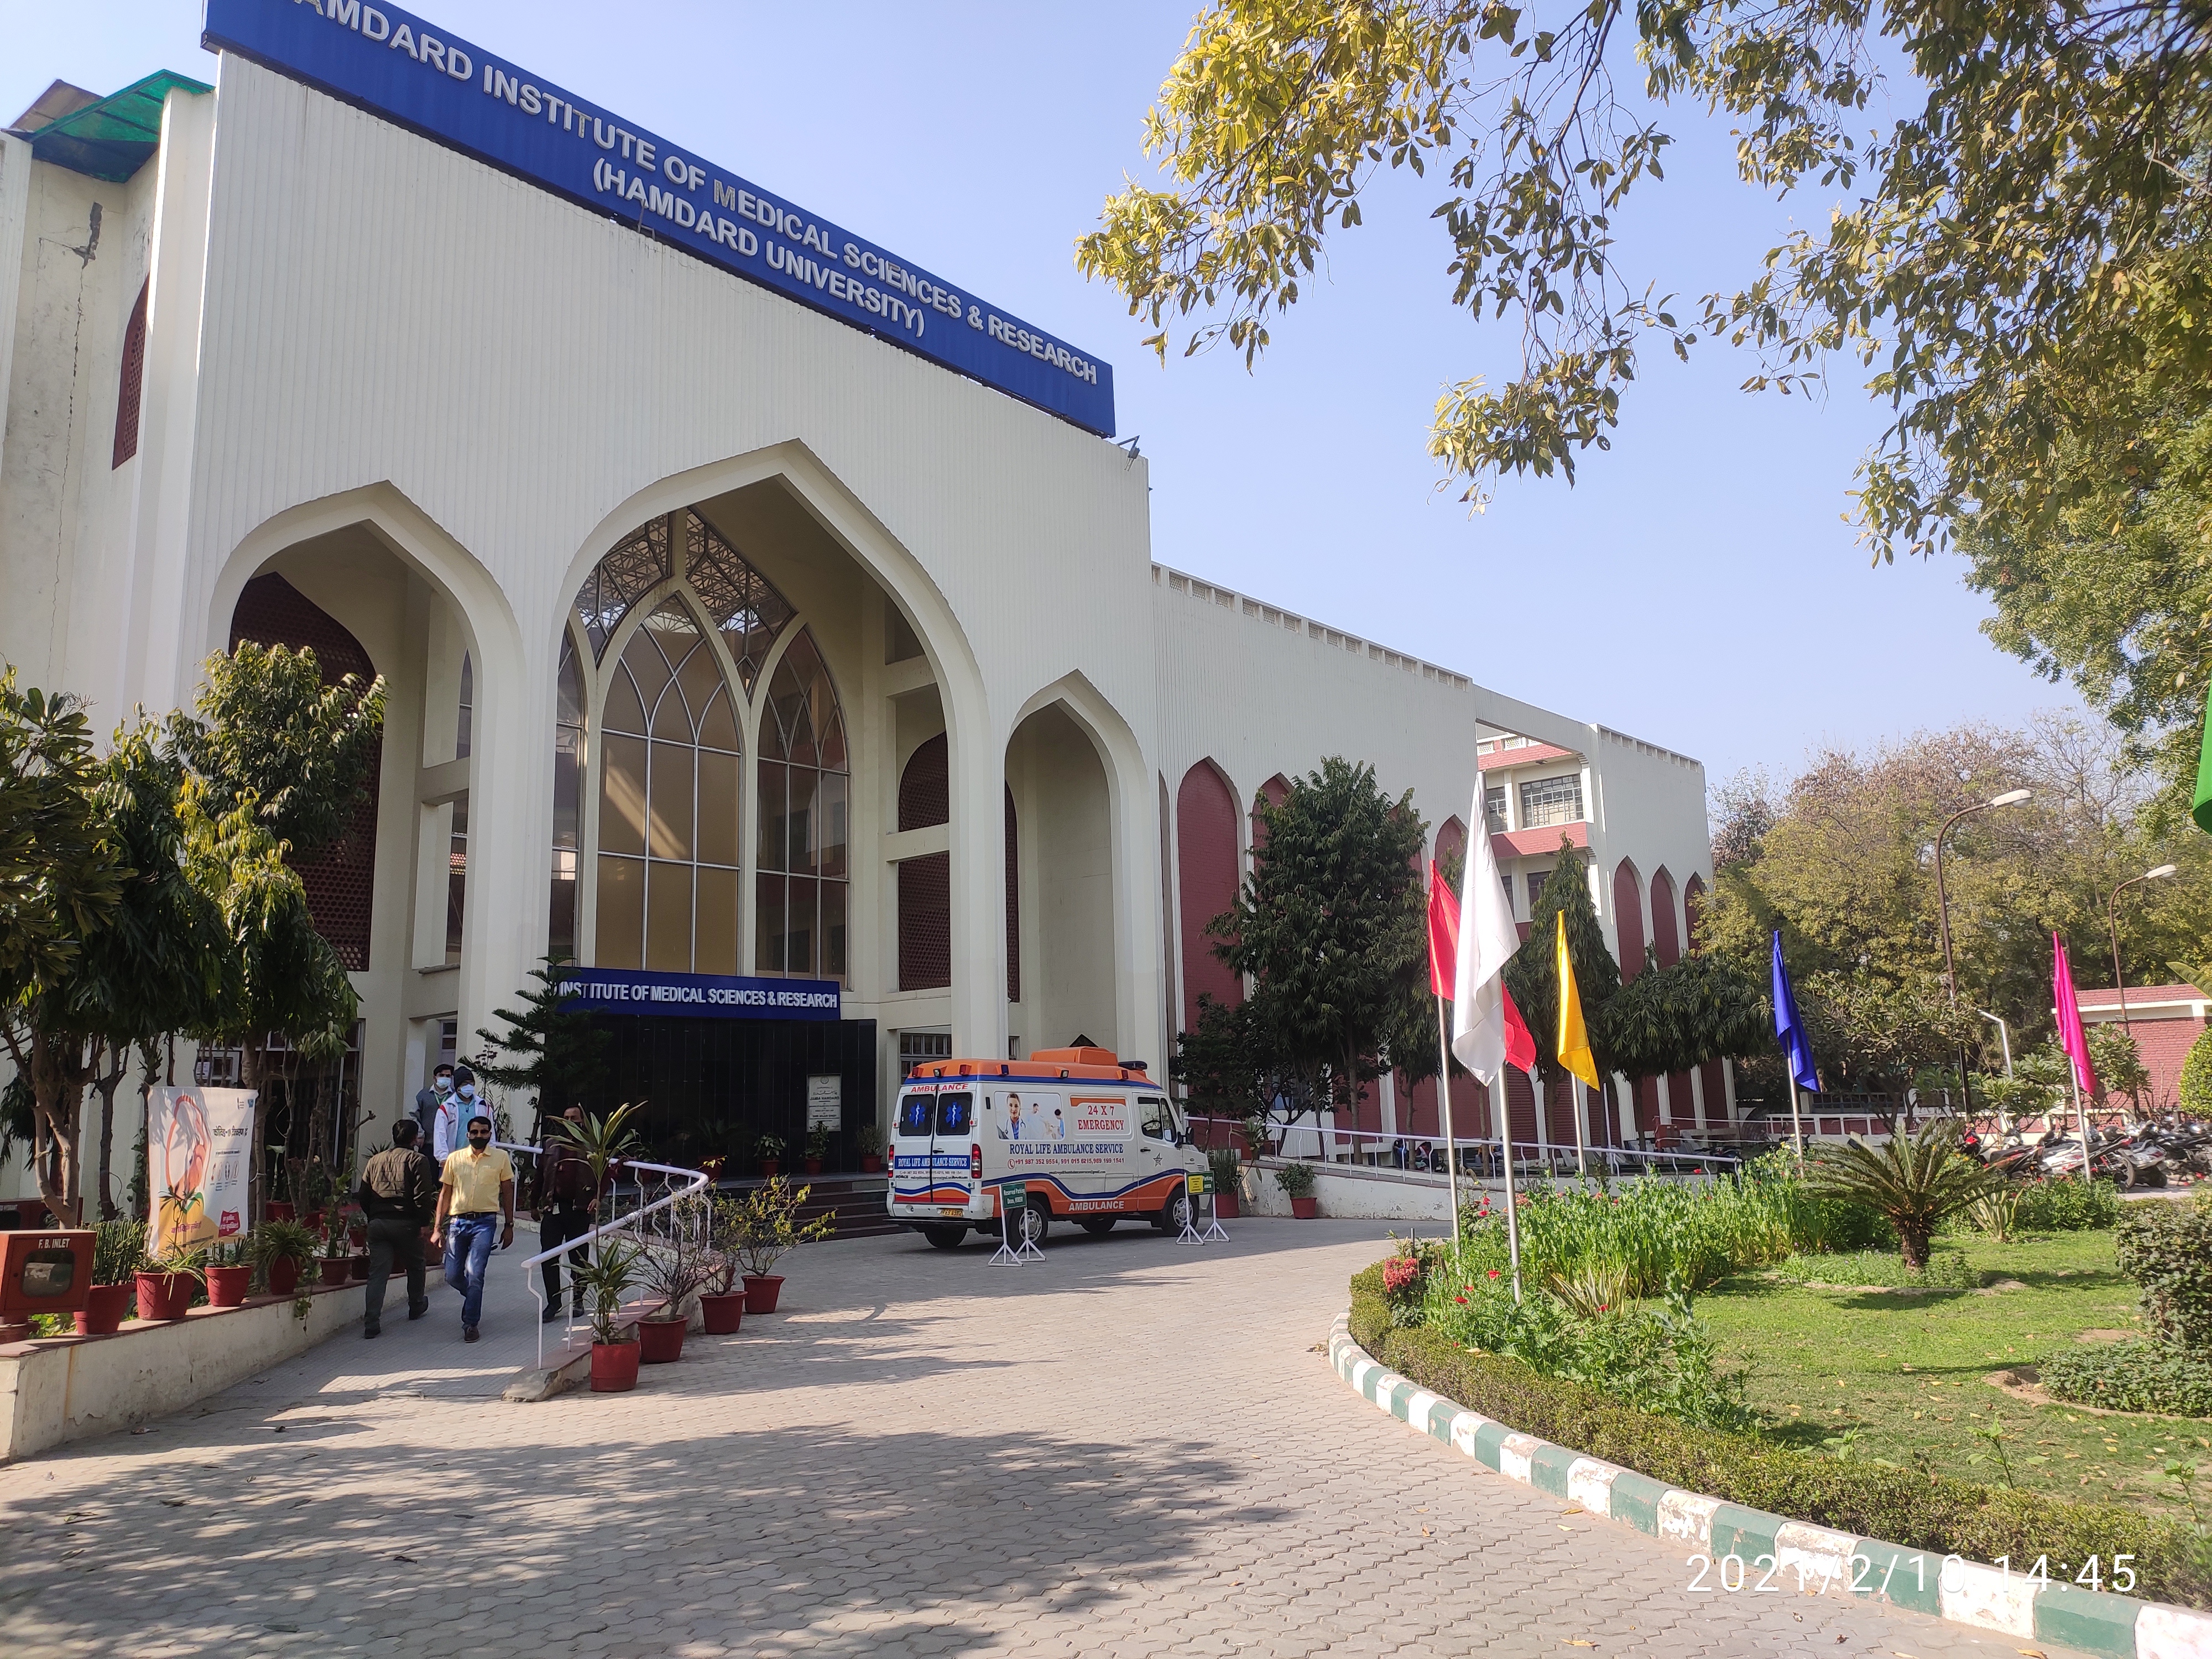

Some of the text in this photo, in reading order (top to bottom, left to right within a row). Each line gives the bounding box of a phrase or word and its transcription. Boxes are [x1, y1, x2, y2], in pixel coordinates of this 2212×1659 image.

[483, 65, 656, 171] INSTITUTE
[664, 155, 706, 191] OF
[714, 179, 838, 260] MEDICAL
[843, 242, 962, 319] SCIENCES
[967, 305, 984, 331] &
[988, 314, 1097, 385] RESEARCH
[593, 158, 925, 338] (HAMDARD UNIVERSITY)
[630, 985, 650, 1001] OF
[650, 985, 706, 1003] MEDICAL
[707, 988, 766, 1005] SCIENCES
[767, 991, 776, 1005] &
[777, 992, 837, 1008] RESEARCH
[911, 1084, 969, 1093] AMBULANCE
[1087, 1105, 1114, 1115] 24 X 7
[1077, 1119, 1124, 1130] EMERGENCY
[1009, 1144, 1124, 1155] ROYAL LIFE AMBULANCE SERVICE
[898, 1158, 911, 1167] ROYAL
[912, 1158, 921, 1167] LIFE
[948, 1157, 967, 1167] SERVICE
[1068, 1201, 1124, 1211] AMBULANCE
[38, 1238, 71, 1249] F. B. INLET
